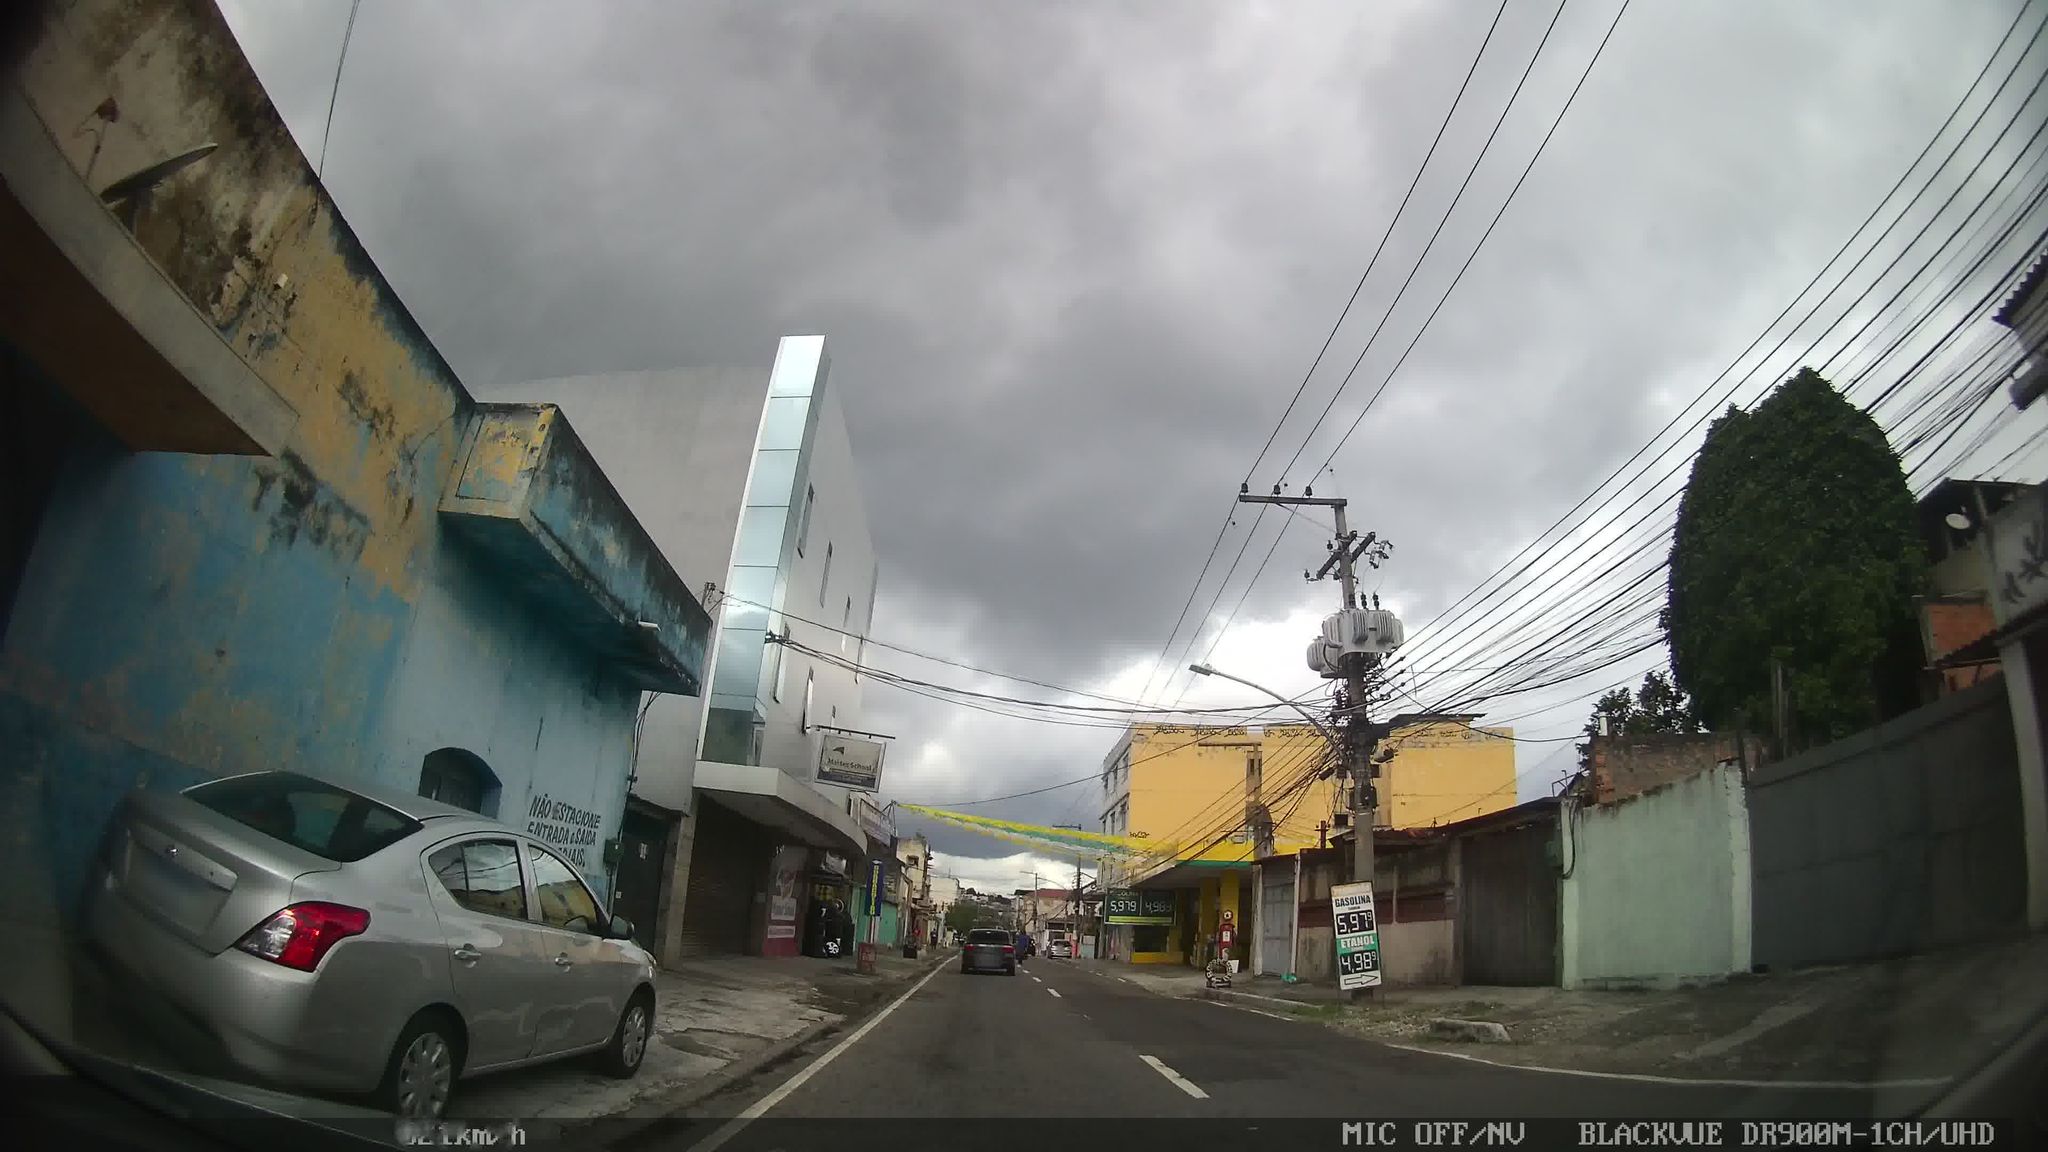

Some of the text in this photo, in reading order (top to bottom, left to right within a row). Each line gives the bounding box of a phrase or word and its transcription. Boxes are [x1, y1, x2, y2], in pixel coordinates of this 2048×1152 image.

[529, 793, 601, 829] NÃO ESTACIONE
[527, 820, 570, 844] ENTRADA
[1110, 900, 1137, 913] 5,979
[1335, 895, 1371, 907] GASOLINA
[1337, 911, 1373, 934] 5,979
[1340, 935, 1375, 949] ETANOL
